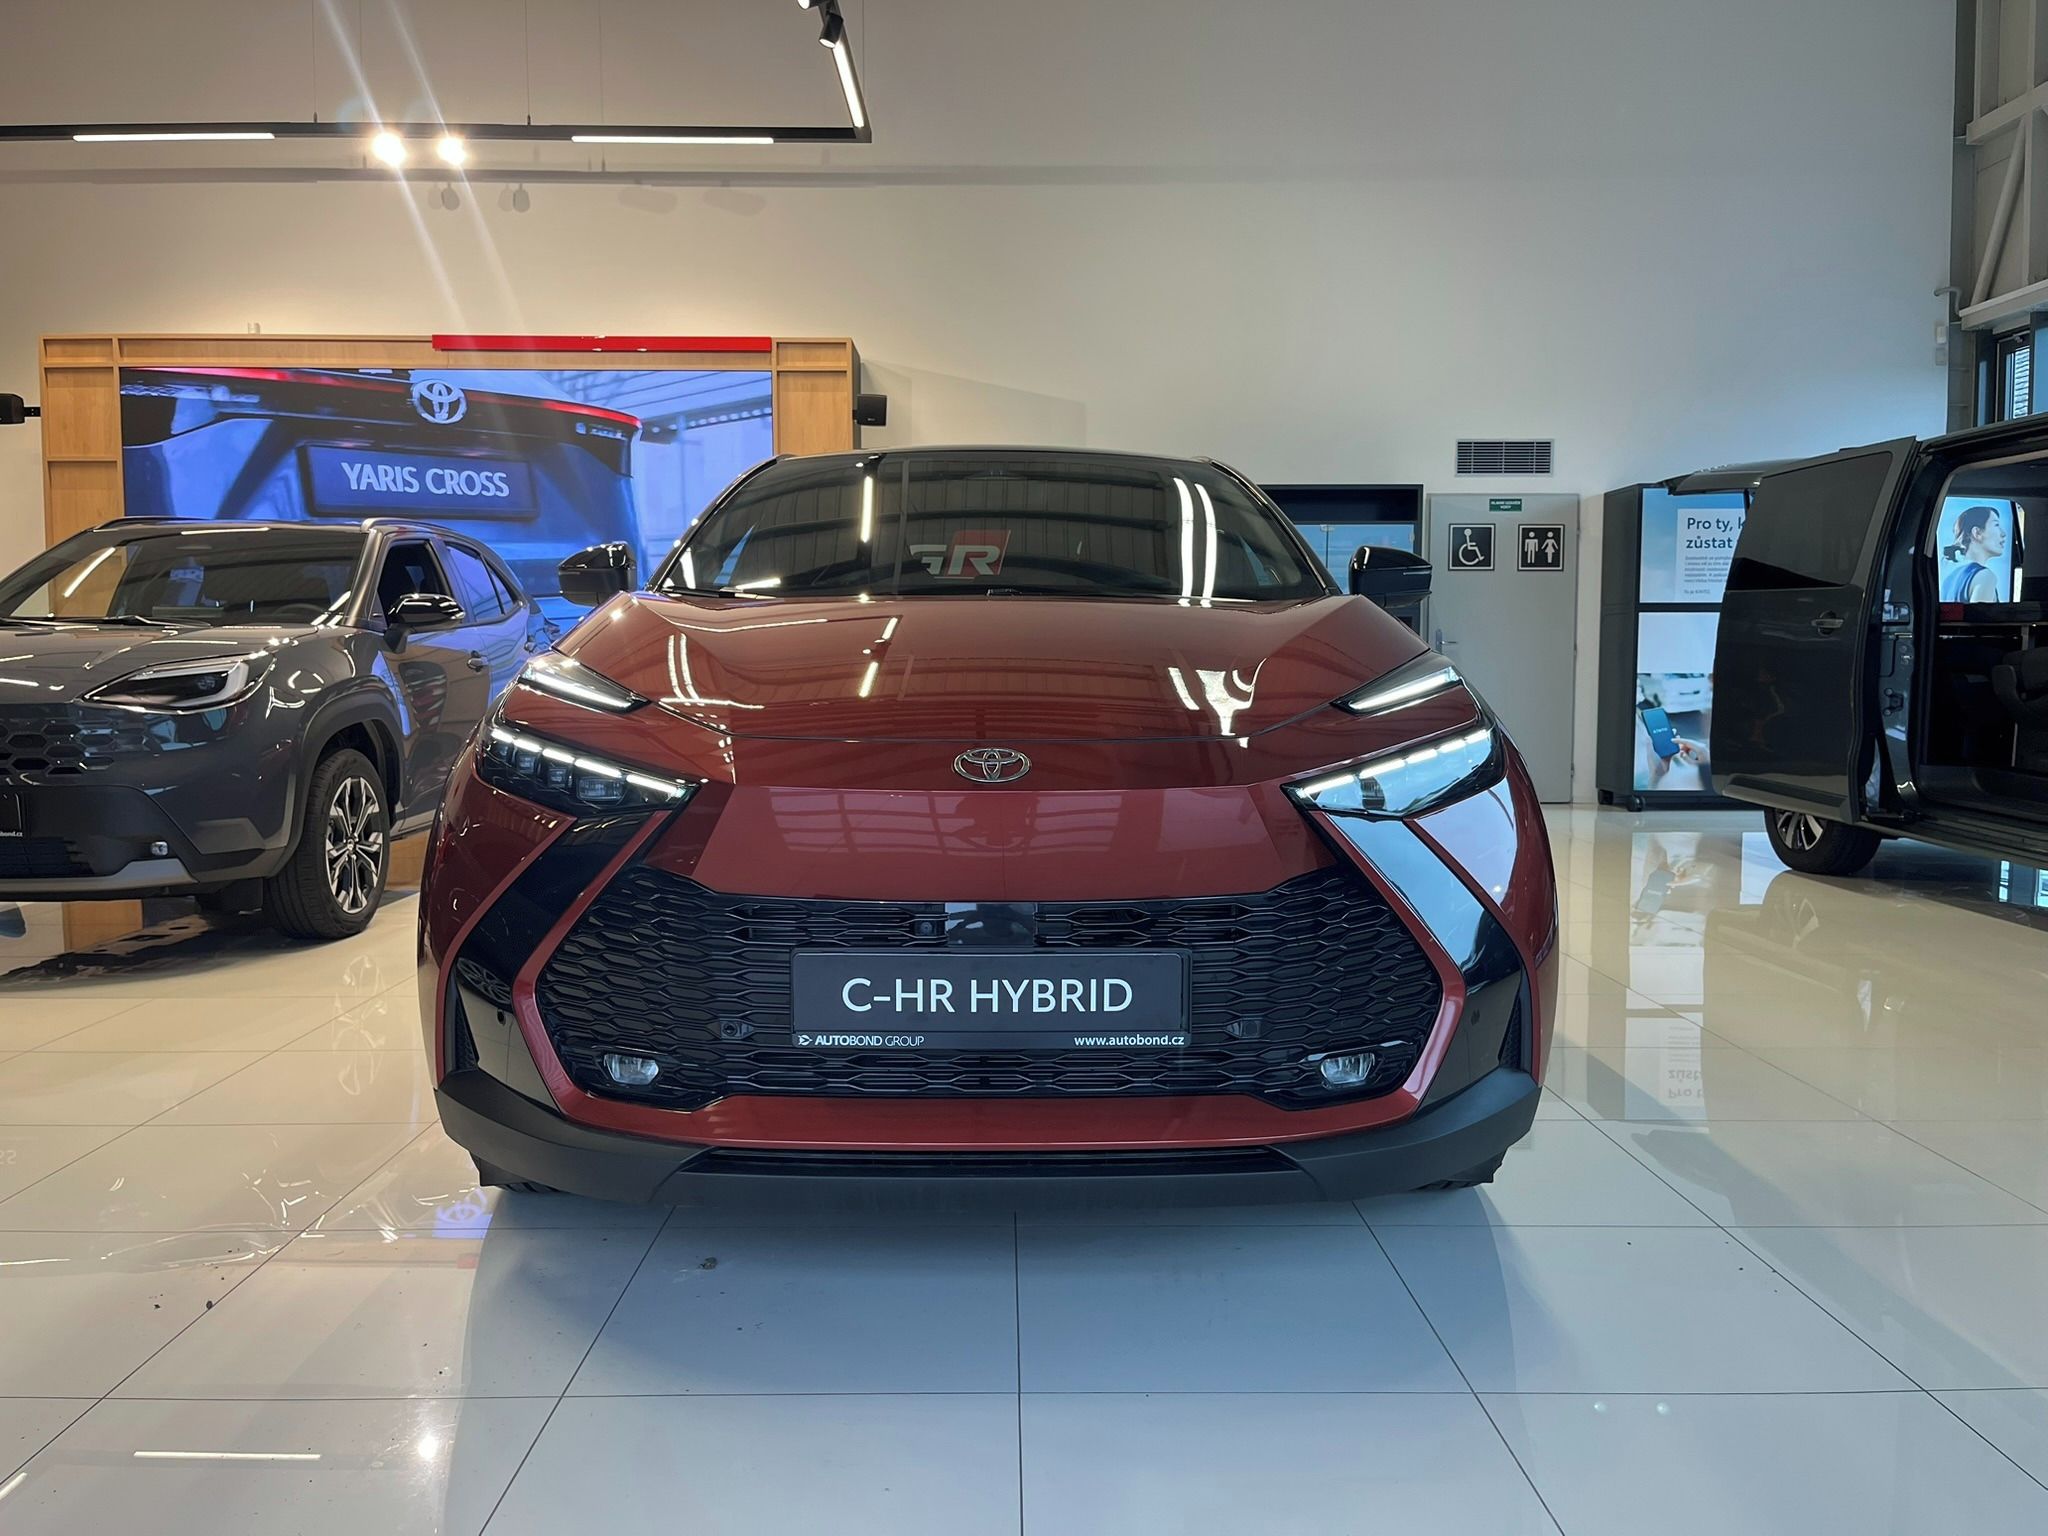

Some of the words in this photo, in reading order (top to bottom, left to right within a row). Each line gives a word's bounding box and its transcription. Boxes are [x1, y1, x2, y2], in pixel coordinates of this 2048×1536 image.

[341, 462, 420, 493] YARIS
[425, 468, 510, 497] CROSS
[1687, 517, 1712, 530] Pro
[1716, 518, 1733, 533] ty,
[1686, 536, 1733, 549] zůstat
[842, 977, 956, 1013] C-HR
[970, 978, 1134, 1013] HYBRID
[814, 1035, 883, 1047] AUTOBOND
[884, 1035, 925, 1047] GROUP
[1074, 1034, 1185, 1046] www.autobond.cz
